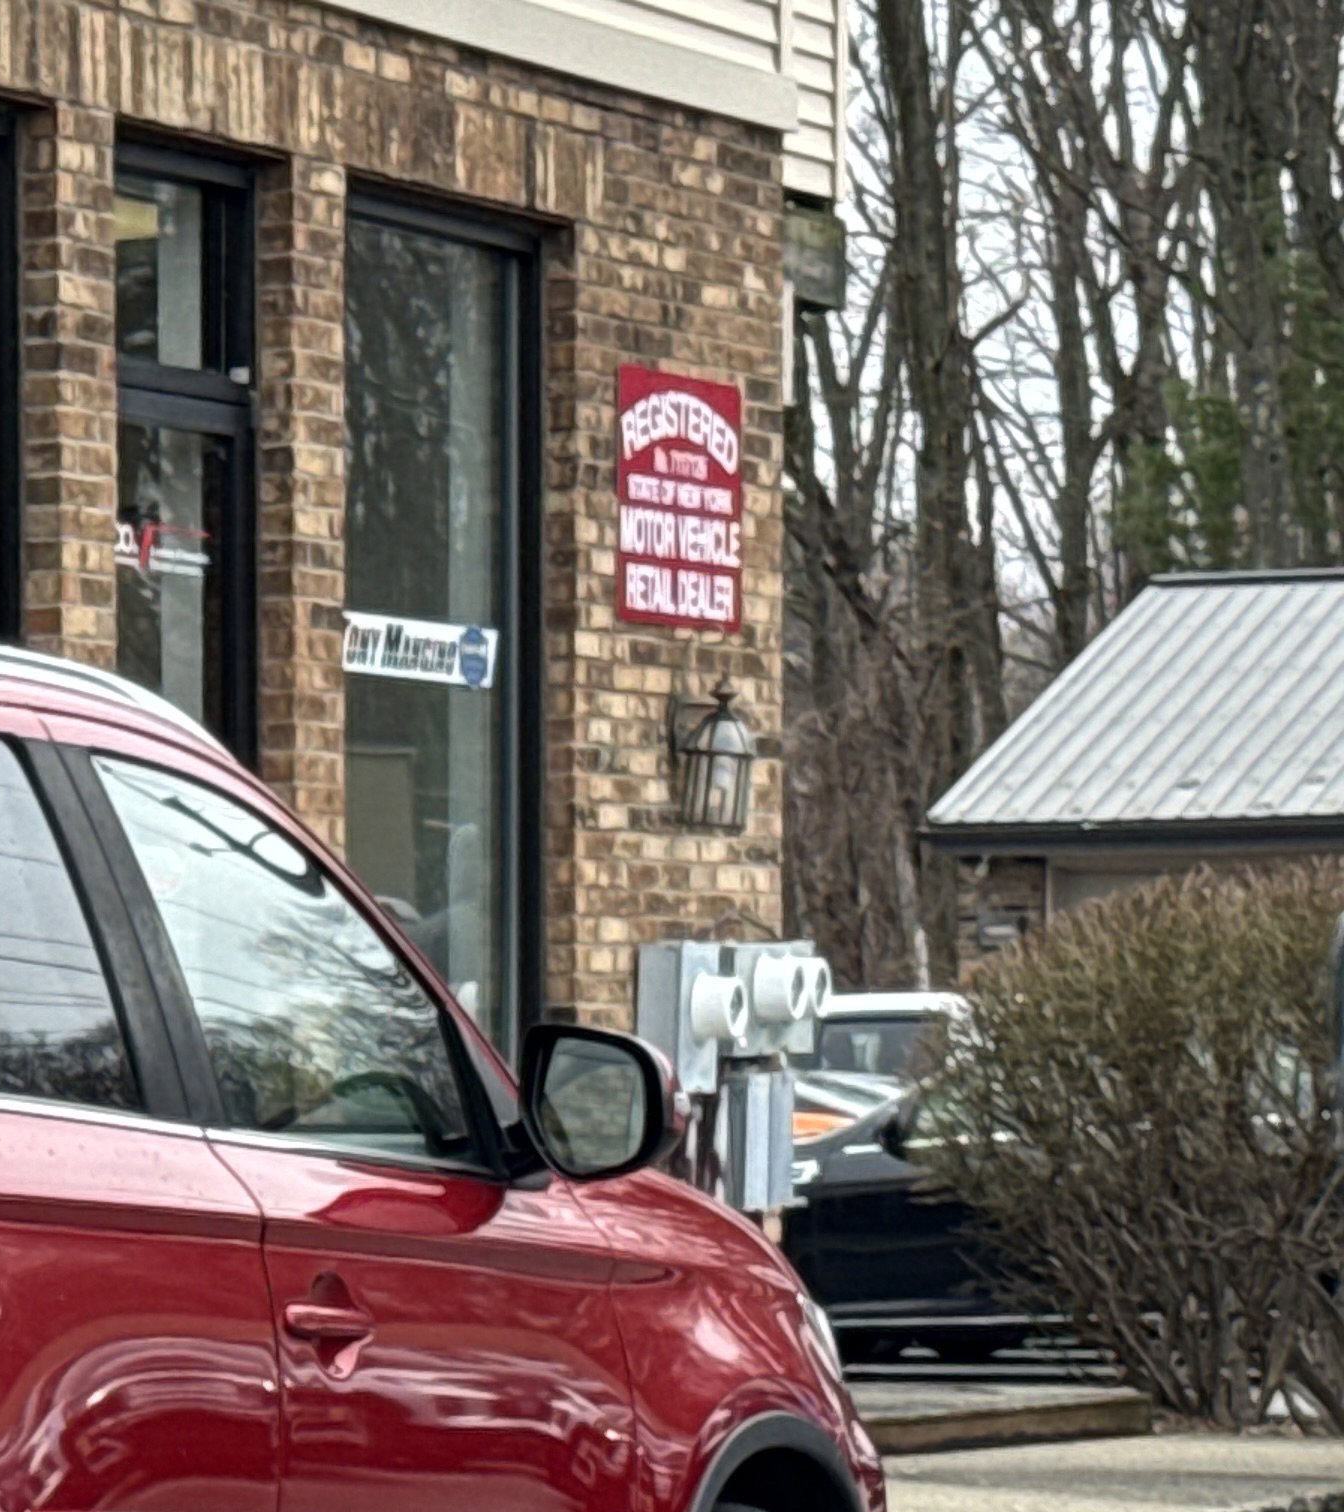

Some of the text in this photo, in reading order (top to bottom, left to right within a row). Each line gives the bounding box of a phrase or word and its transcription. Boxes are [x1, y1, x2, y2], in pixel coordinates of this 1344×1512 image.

[621, 390, 739, 475] REGISTERED
[620, 504, 741, 569] MOTOR VEHICLE
[626, 561, 735, 622] RETAIL DEALER
[346, 624, 382, 667] ONY
